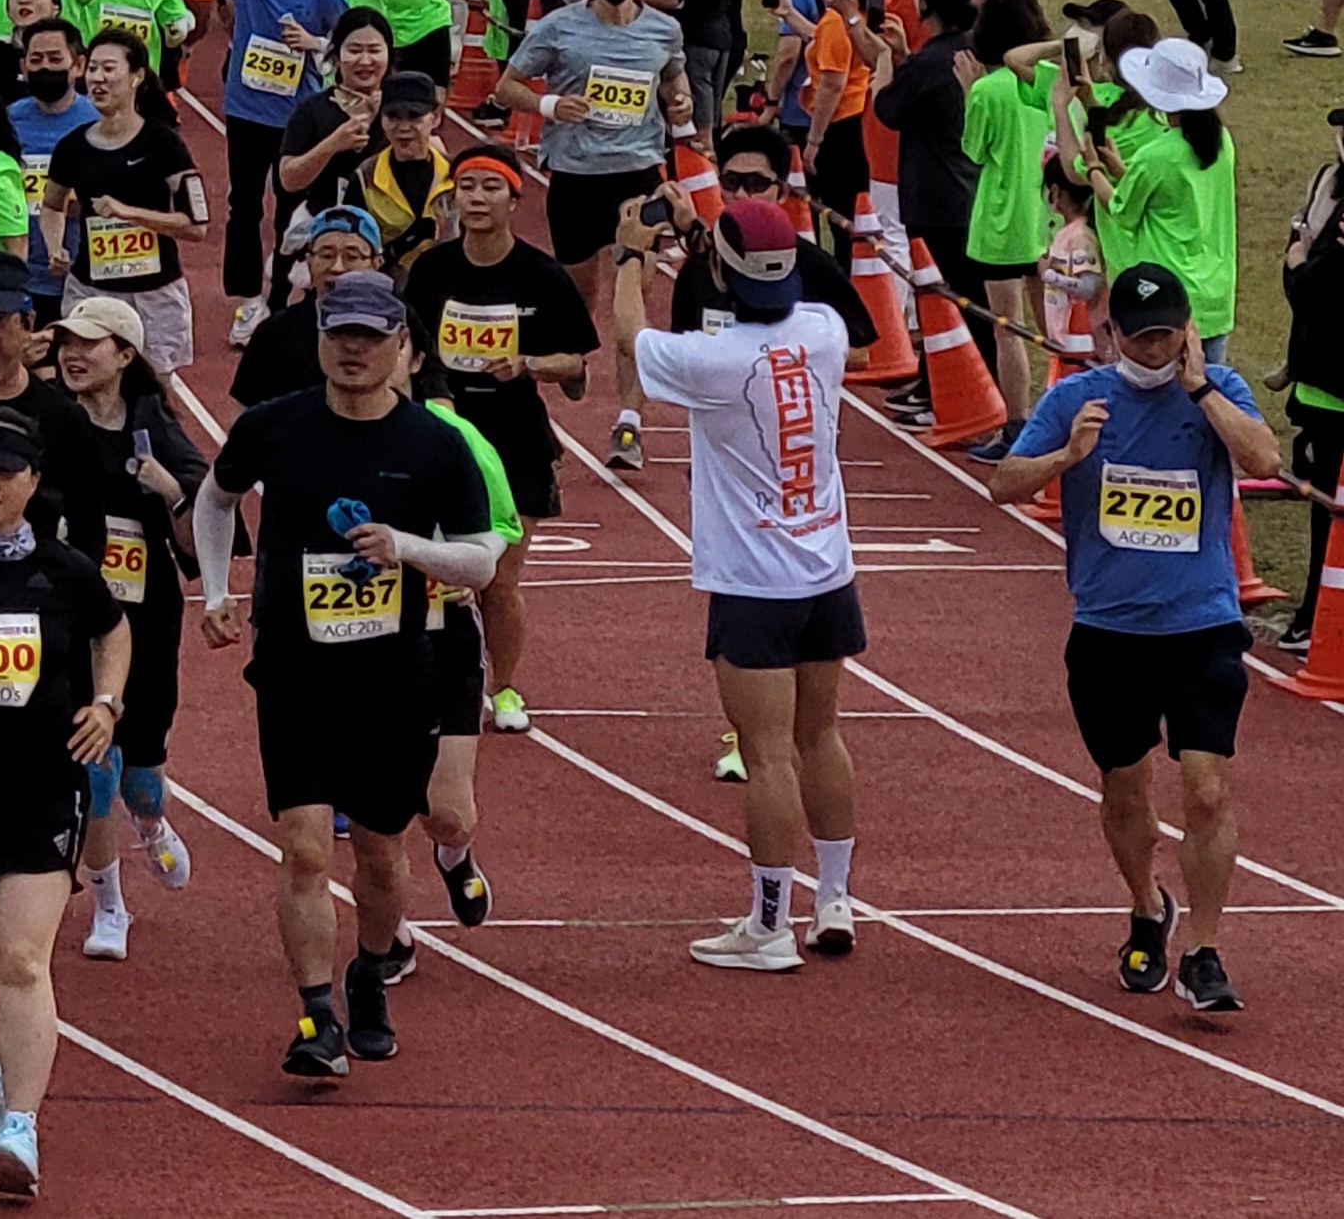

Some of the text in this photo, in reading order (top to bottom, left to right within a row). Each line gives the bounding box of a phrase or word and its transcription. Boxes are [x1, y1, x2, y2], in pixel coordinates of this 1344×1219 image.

[245, 52, 297, 80] 2591
[590, 84, 646, 106] 2033
[92, 231, 154, 257] 3120
[442, 323, 514, 349] 3147
[1105, 490, 1196, 523] 2720
[1118, 530, 1182, 548] AGE20's
[103, 543, 143, 571] 56
[309, 578, 397, 610] 2267
[323, 621, 383, 637] AGE20's
